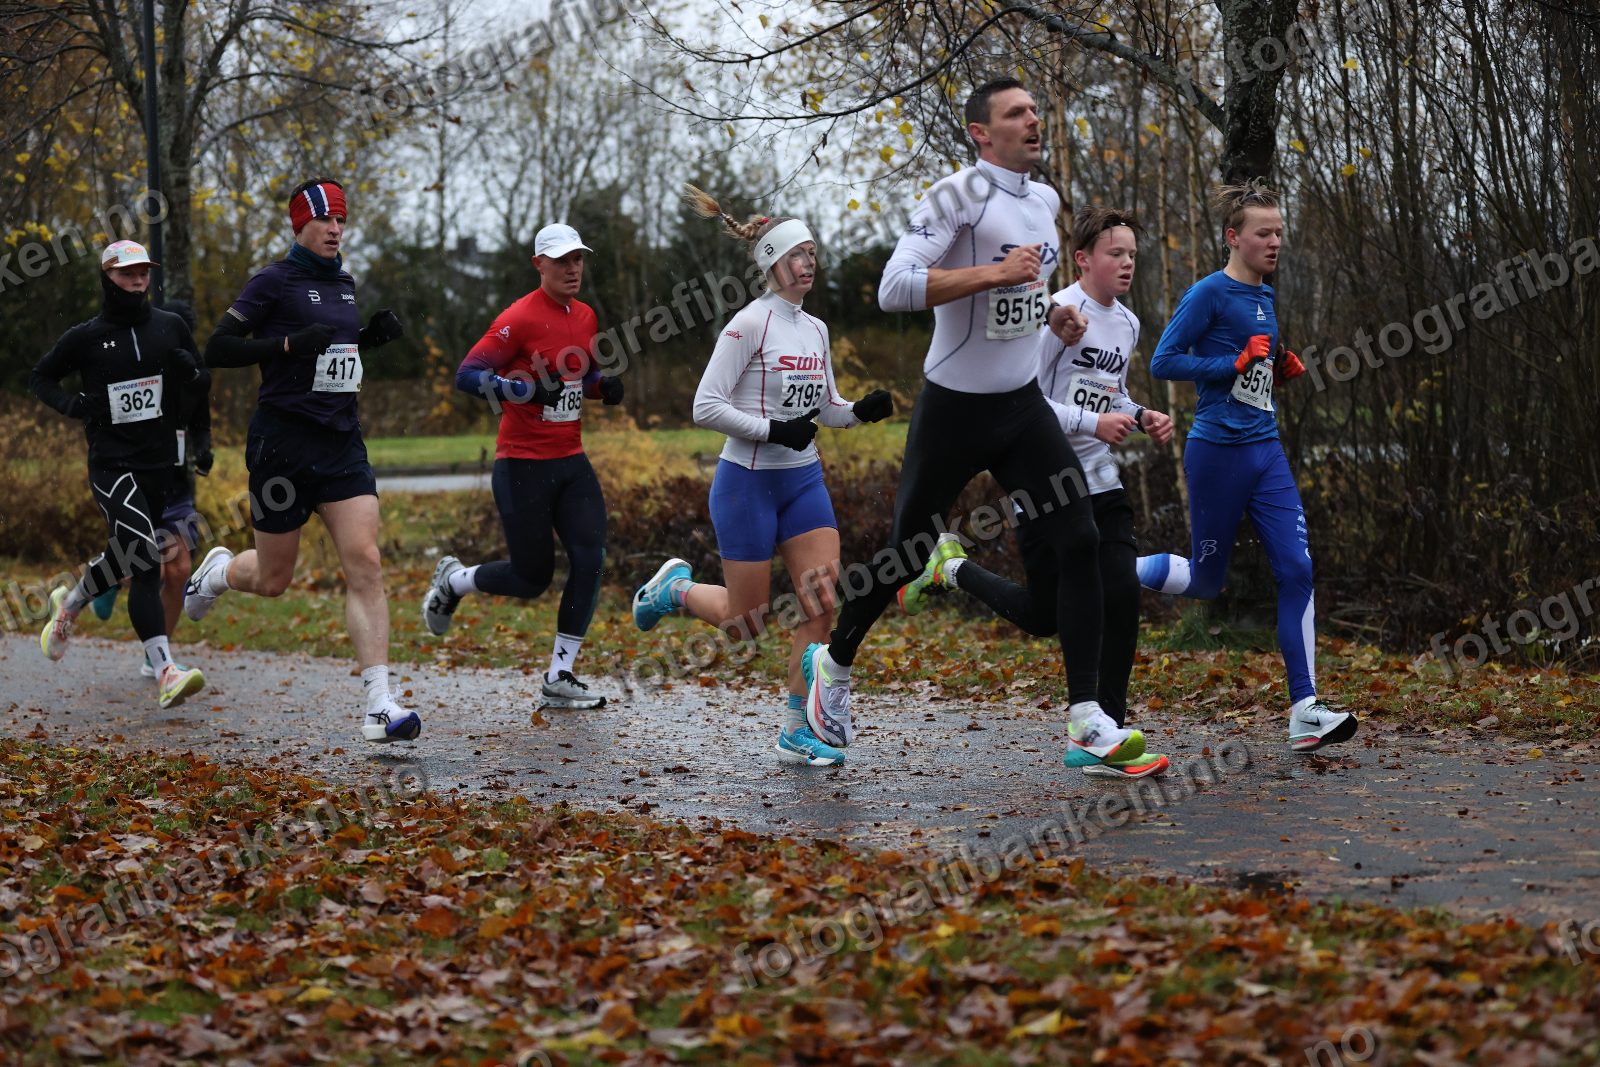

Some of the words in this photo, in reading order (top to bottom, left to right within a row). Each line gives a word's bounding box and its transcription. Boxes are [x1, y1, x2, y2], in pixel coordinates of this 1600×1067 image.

[992, 242, 1059, 265] Six
[995, 292, 1045, 326] 9515
[326, 357, 356, 380] 417
[782, 383, 823, 408] 2195
[1240, 368, 1272, 399] 9514
[120, 388, 156, 413] 362
[1073, 388, 1113, 414] 950
